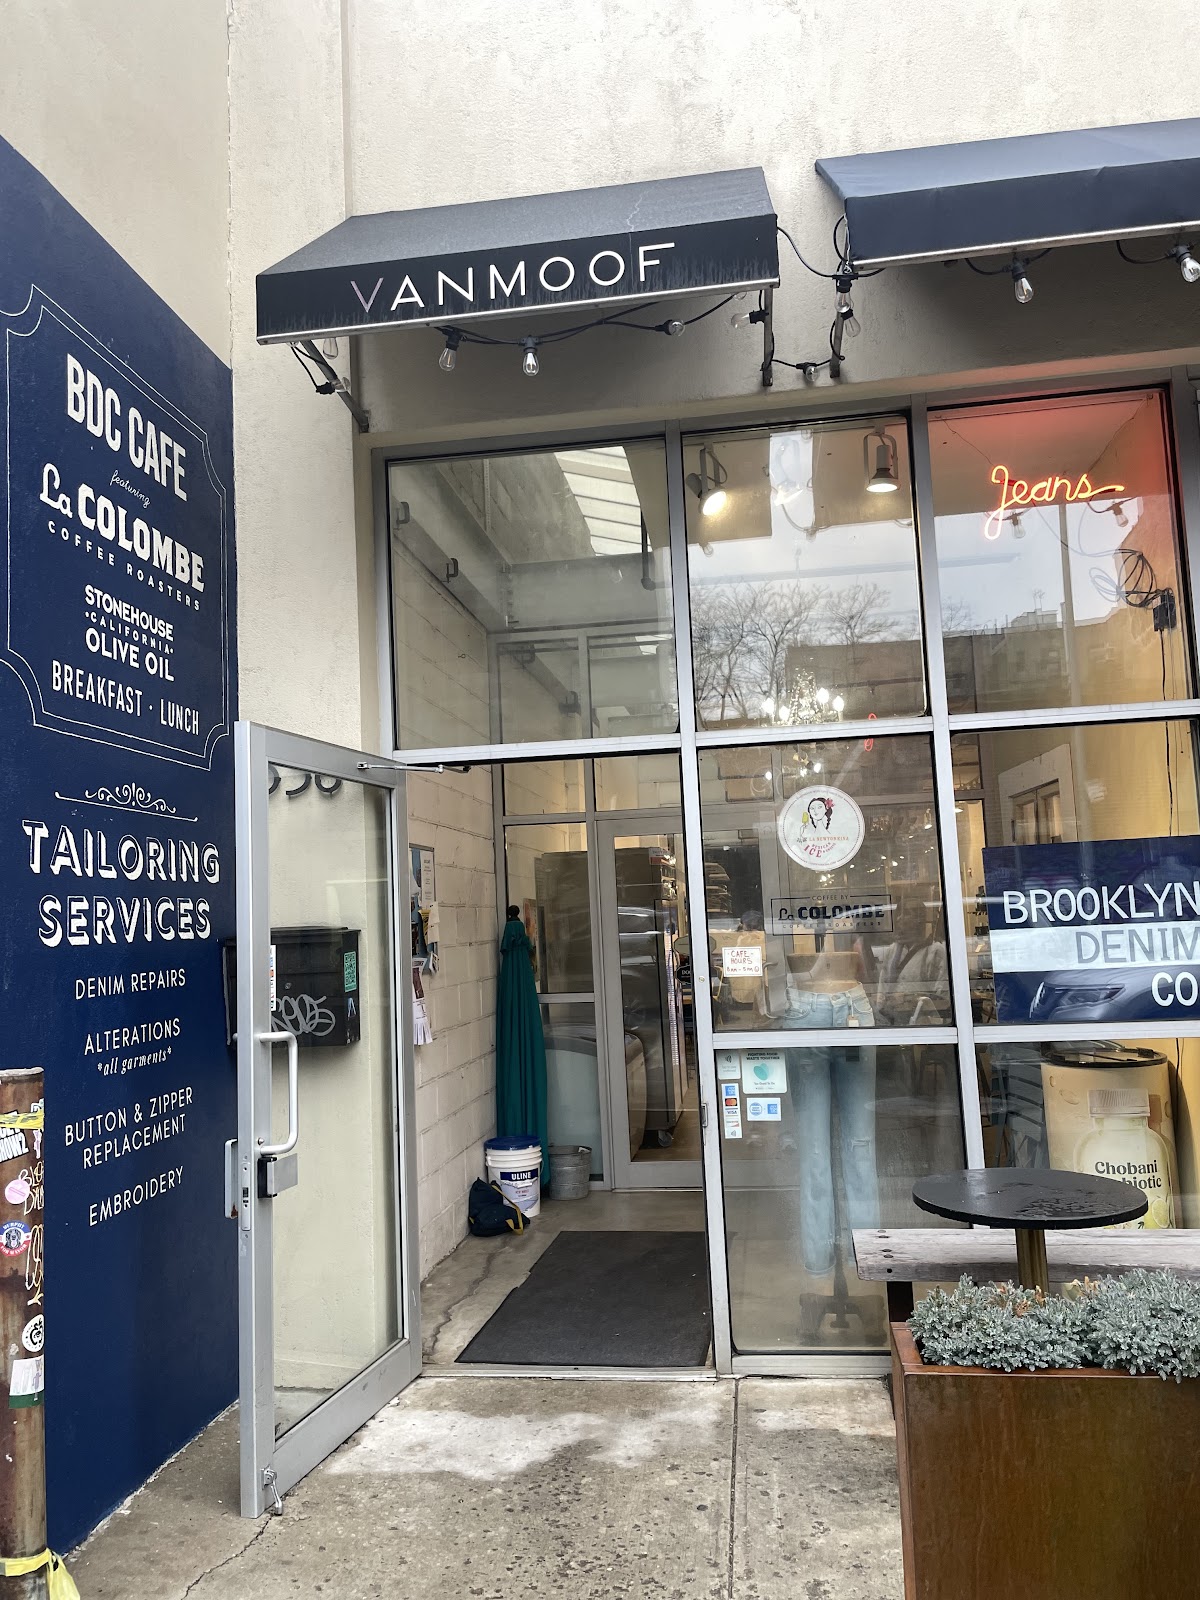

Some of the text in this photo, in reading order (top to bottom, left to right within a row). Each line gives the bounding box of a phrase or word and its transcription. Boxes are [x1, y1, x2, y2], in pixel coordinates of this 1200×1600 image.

[350, 242, 675, 313] VANMOOF
[67, 353, 187, 501] BDC CAFE
[110, 470, 151, 508] featuring
[984, 465, 1125, 540] Jeans
[40, 463, 205, 592] La COLOMBE
[48, 521, 200, 611] COFFEE ROASTERS
[85, 584, 174, 642] STONEHOUSE
[85, 611, 174, 654] CALIFORNIA
[85, 627, 175, 682] OLIVE OIL
[52, 660, 199, 736] BREAKFAST LUNCH
[22, 819, 220, 884] TAILORING
[38, 894, 211, 948] SERVICES
[778, 907, 795, 921] La
[1003, 880, 1200, 924] BROOKLYN
[730, 957, 753, 965] HOURS
[731, 950, 750, 958] CAFE
[1074, 926, 1200, 964] DENIM
[75, 968, 186, 1000] DENIM REPAIRS
[1151, 971, 1199, 1007] CO
[84, 1017, 181, 1056] ALTERATIONS
[65, 1107, 127, 1147] BUTTON
[134, 1103, 143, 1123] &
[149, 1086, 193, 1118] ZIPPER
[83, 1113, 186, 1170] REPLACEMENT
[511, 1171, 532, 1180] ULINE
[1094, 1160, 1158, 1175] Chobani
[89, 1165, 184, 1227] EMBROIDERY
